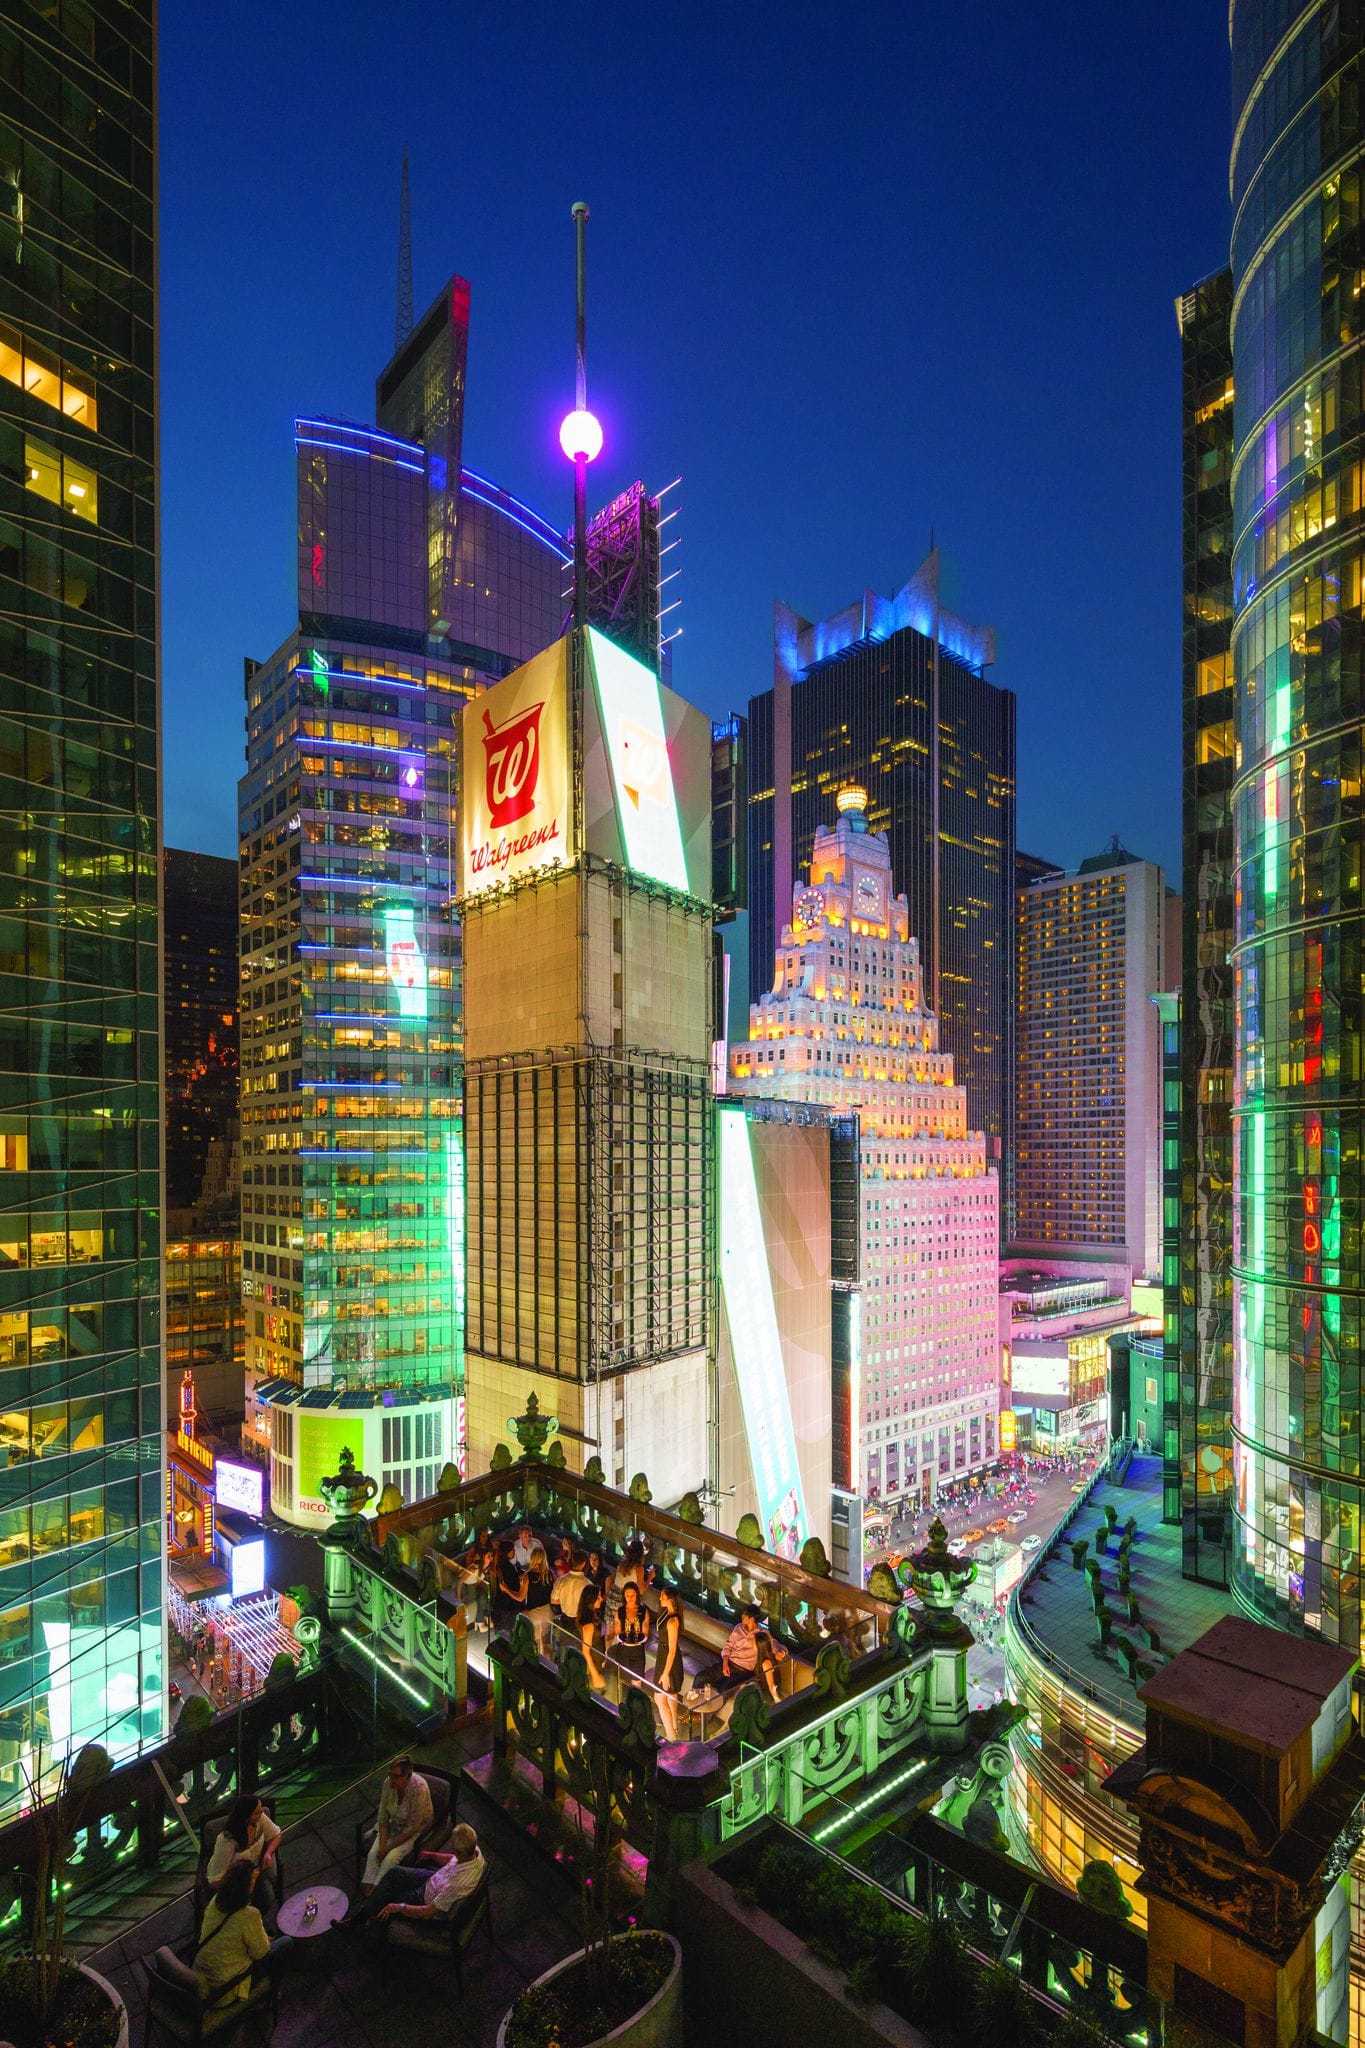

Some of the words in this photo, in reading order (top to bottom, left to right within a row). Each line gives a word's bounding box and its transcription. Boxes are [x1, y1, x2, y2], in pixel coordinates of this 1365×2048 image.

[488, 725, 536, 804] W
[470, 818, 560, 874] Walgreens
[299, 1501, 330, 1513] RICO
